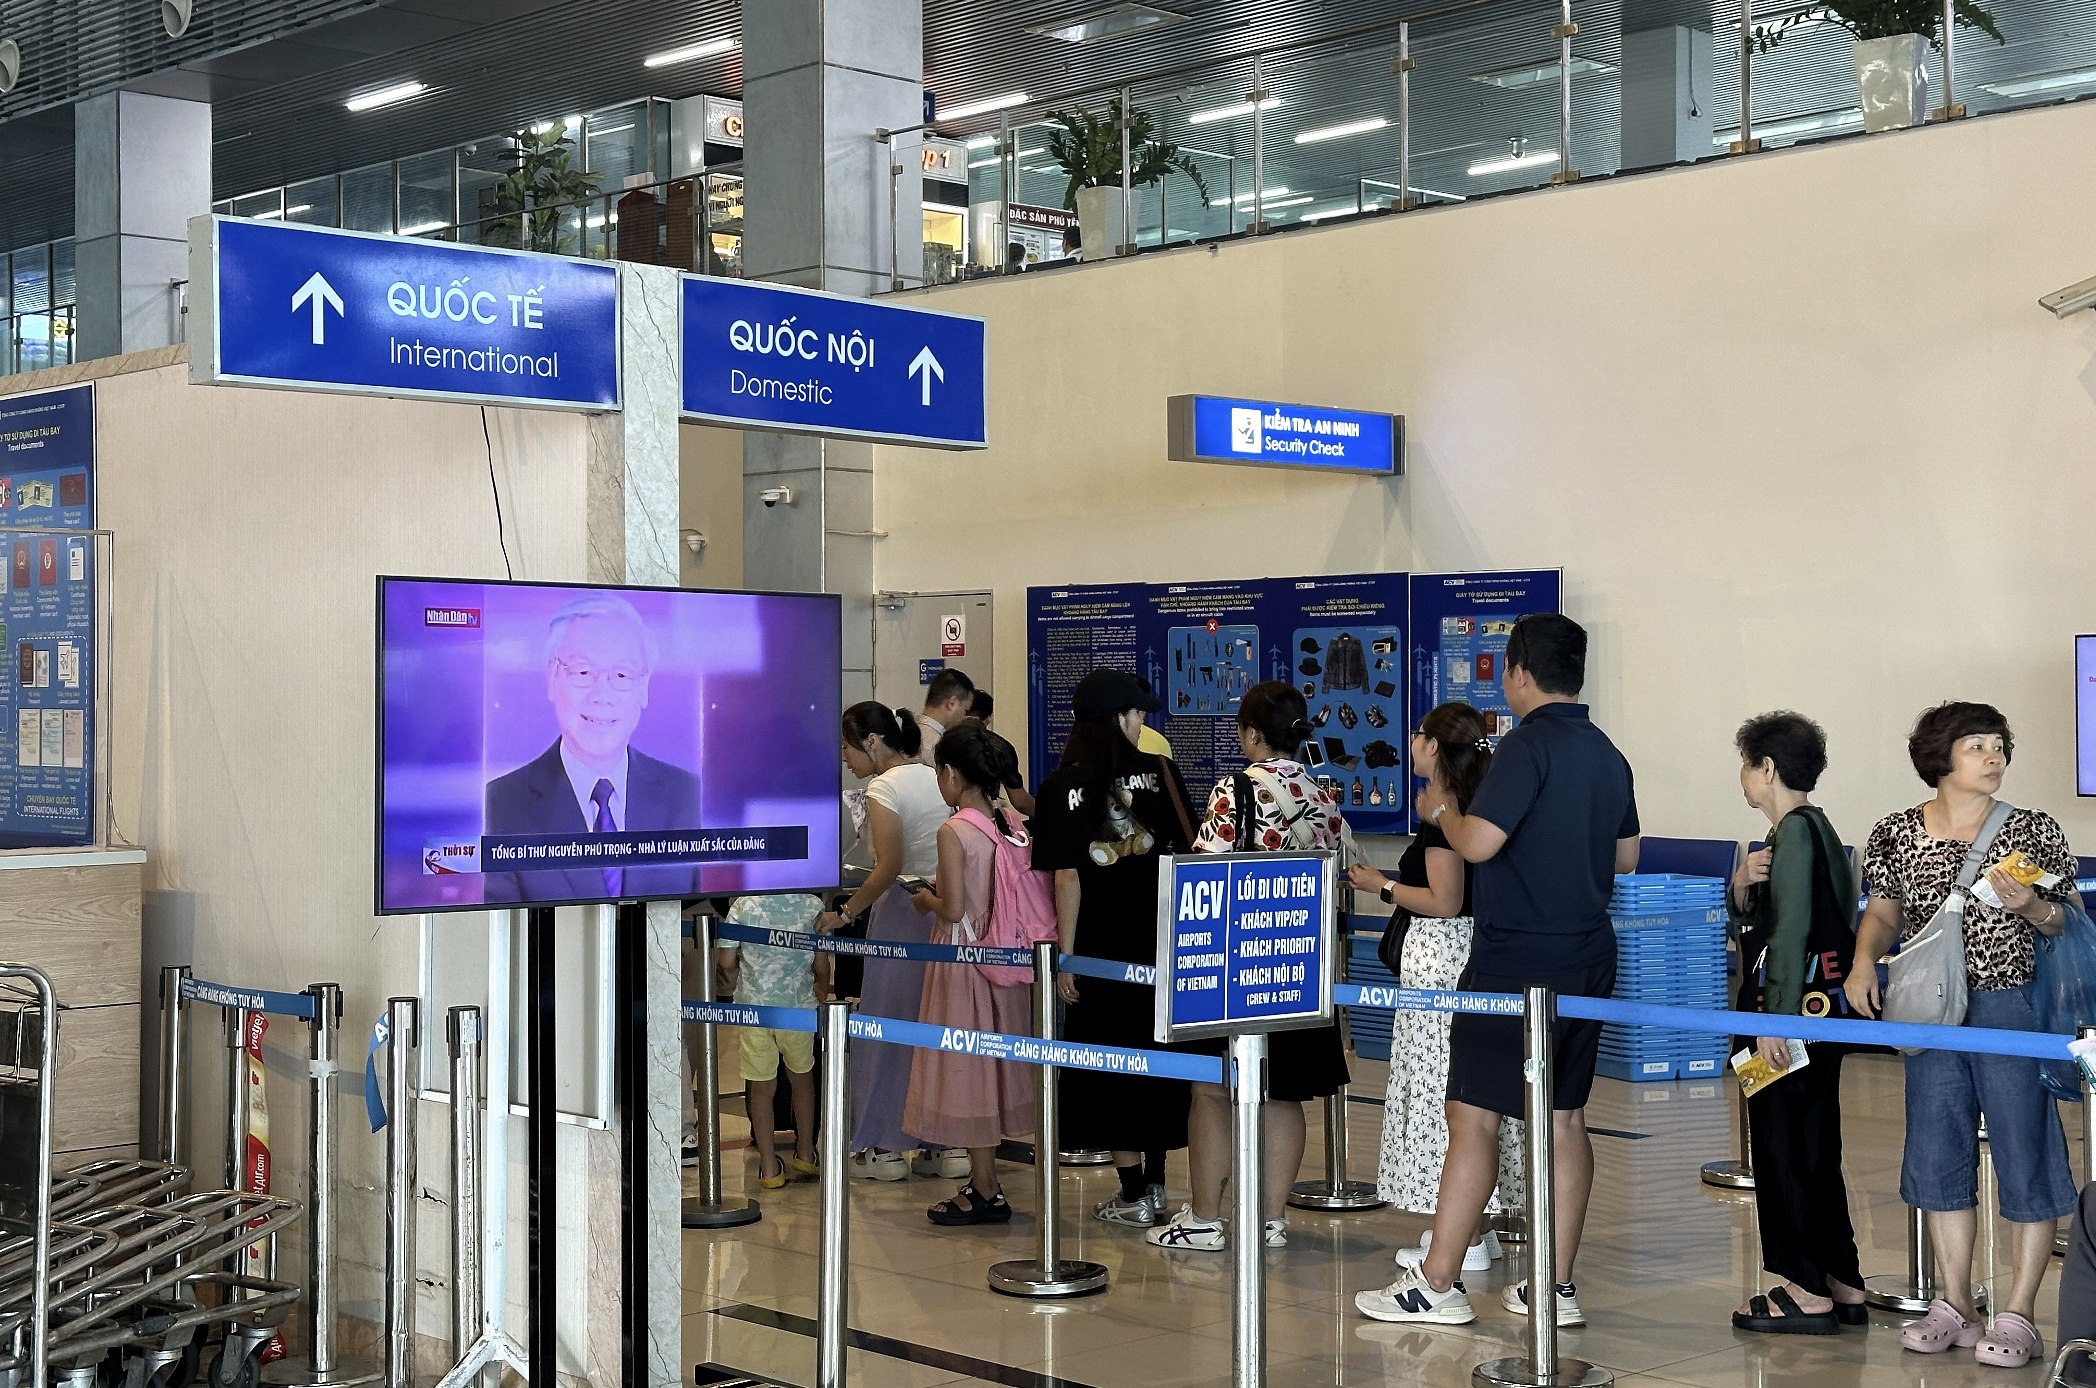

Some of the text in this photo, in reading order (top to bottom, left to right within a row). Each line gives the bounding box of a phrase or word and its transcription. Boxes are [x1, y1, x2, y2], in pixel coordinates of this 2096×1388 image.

[1010, 208, 1027, 222] ĐẶC
[1029, 210, 1047, 223] SẢN
[1048, 215, 1065, 226] PHÚ
[387, 276, 546, 329] QUỐC TẾ
[730, 316, 875, 372] QUỐC NỘI
[390, 336, 558, 378] International
[731, 369, 833, 405] Domestic
[1264, 408, 1360, 438] KIỂM TRA AN NINH
[1264, 436, 1346, 457] Security Check
[427, 610, 450, 622] Nhân
[450, 610, 467, 622] Dân
[920, 662, 927, 672] G
[24, 805, 79, 816] INTERNATIONAL FLIGHTS
[463, 846, 475, 858] SỰ
[492, 835, 765, 860] TỔNG BÍ THƯ NGUYỄN PHÚ TRỌNG NHÀ LÝ LUẬN XUẤT SẮC CỦA ĐẢNG
[1237, 872, 1316, 901] LỐI ĐI ƯU TIÊN
[1178, 880, 1224, 922] ACV
[1240, 909, 1309, 930] KHÁCH VIP/CIP
[1706, 909, 1721, 923] ACV
[768, 930, 793, 948] ACV
[817, 936, 835, 951] CẢNG
[835, 939, 854, 953] HÀNG
[854, 942, 878, 956] KHÔNG
[878, 944, 892, 957] TUY
[892, 945, 908, 958] HÒA
[1178, 931, 1212, 948] AIRPORTS
[1240, 936, 1316, 958] KHÁCH PRIORITY
[956, 946, 983, 964] ACV
[1012, 952, 1032, 964] CẢNG
[1177, 952, 1225, 970] CORPORATION
[1125, 964, 1156, 984] ACV
[1176, 975, 1218, 992] OF VIETNAM
[1239, 961, 1305, 987] KHÁCH NỘI BỘ
[238, 993, 251, 1008] TUY
[251, 992, 265, 1009] HÒA
[1246, 990, 1301, 1007] (CREW & STAFF)
[1358, 986, 1394, 1006] ACV
[1399, 995, 1432, 1003] CORPORATION
[1433, 992, 1524, 1013] CẢNG HÀNG KHÔNG
[696, 1005, 723, 1022] KHÔNG
[725, 1009, 740, 1023] TUY
[743, 1008, 759, 1024] HÒA
[865, 1020, 882, 1038] HÒA
[980, 1033, 1003, 1042] AIRPORTS
[940, 1028, 977, 1052] ACV
[980, 1041, 1012, 1051] CORPORATION
[987, 1049, 1007, 1058] VIETNAM
[1014, 1041, 1148, 1073] CẢNG HÀNG KHÔNG TUY HÒA
